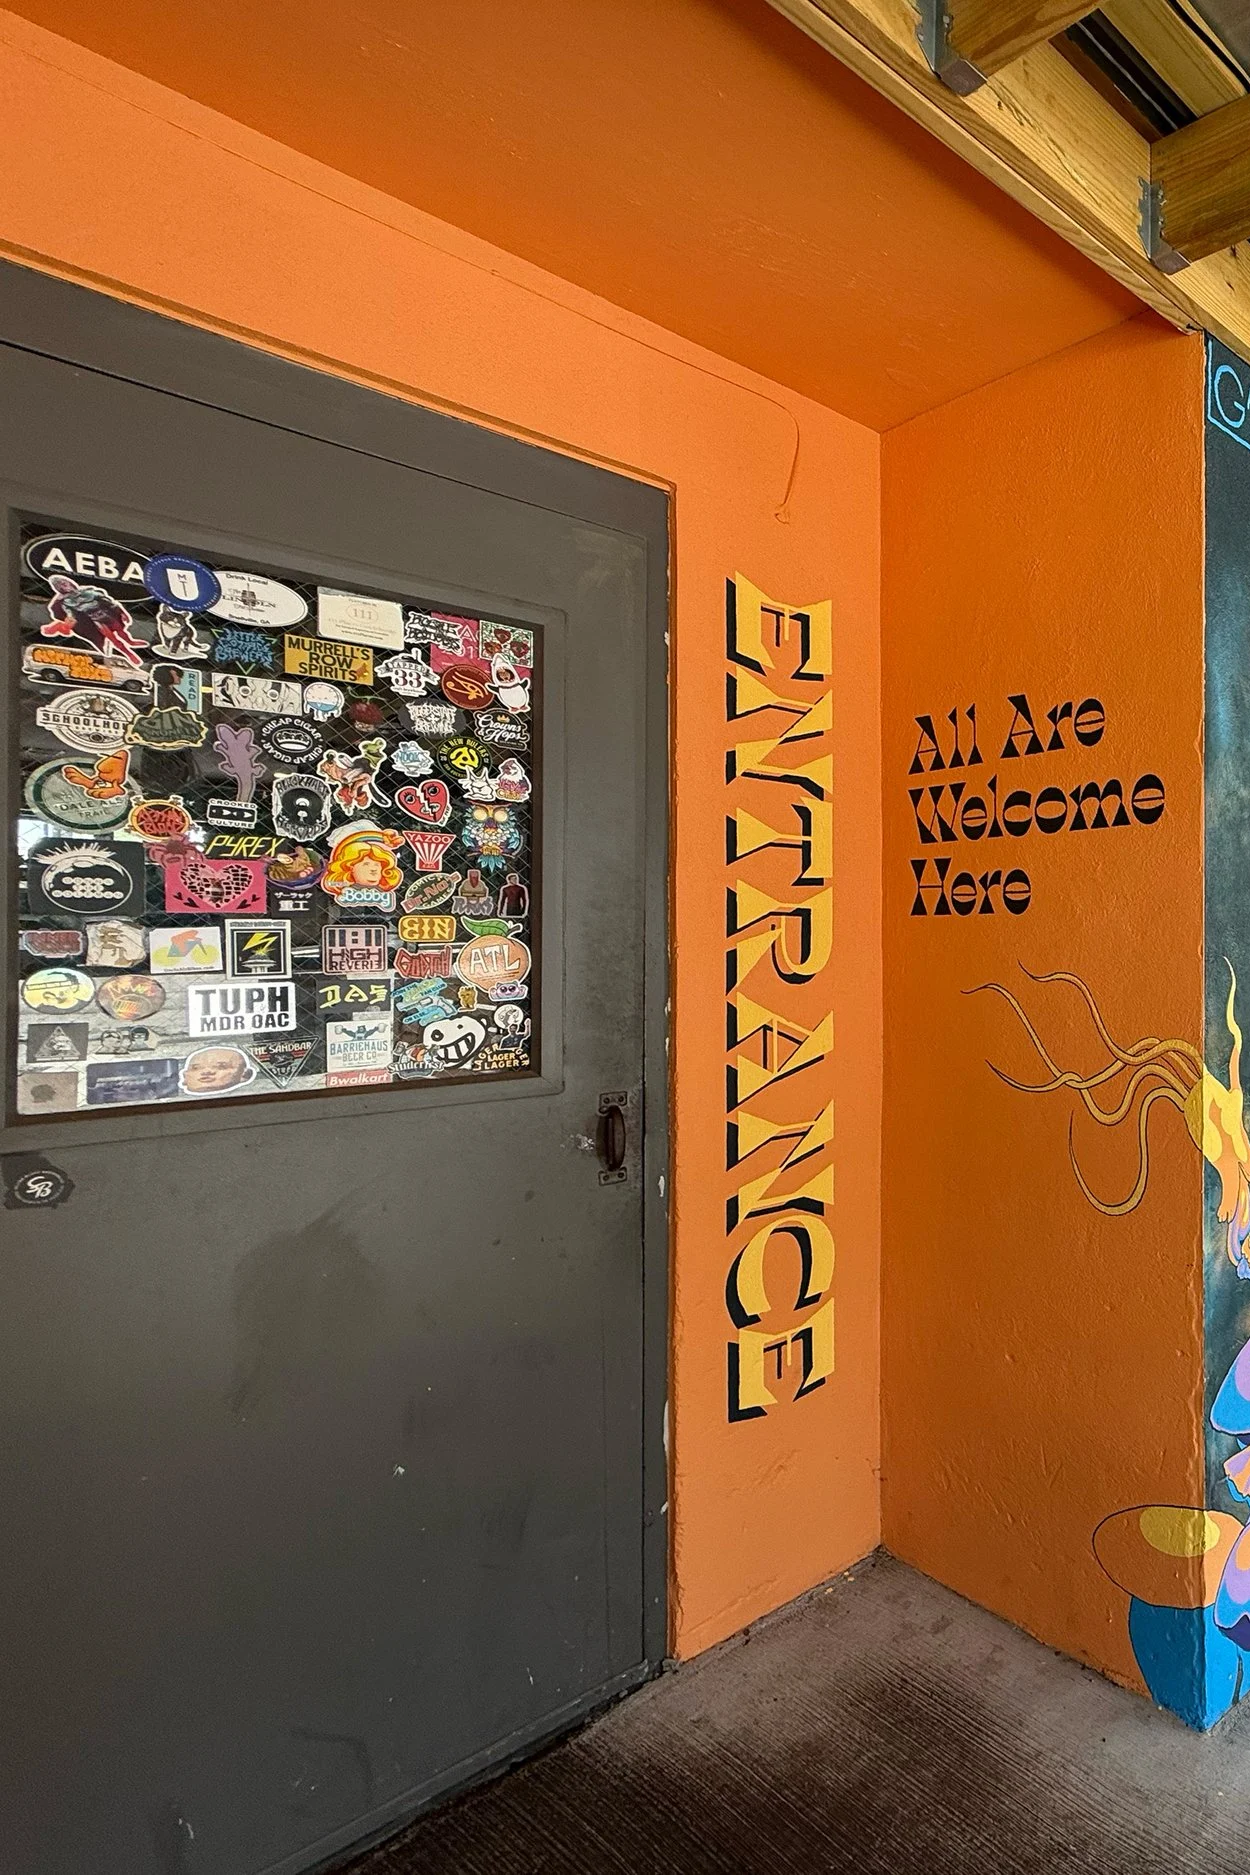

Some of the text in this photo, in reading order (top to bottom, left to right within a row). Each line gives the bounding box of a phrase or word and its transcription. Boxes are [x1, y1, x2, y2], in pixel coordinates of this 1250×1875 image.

[42, 547, 145, 582] AEBA
[225, 573, 268, 586] Drink Local
[287, 637, 371, 660] MURRELL'S
[309, 651, 354, 672] ROW
[299, 662, 358, 681] SPIRITS
[394, 669, 422, 688] 33
[188, 673, 197, 700] READ
[478, 714, 522, 732] Crowns
[449, 738, 464, 747] NEW
[483, 728, 528, 743] Hops
[907, 693, 1107, 775] All Are
[210, 799, 256, 809] CROOKED
[907, 773, 1166, 846] Welcome
[209, 819, 254, 828] CULTURE
[408, 833, 451, 843] YAZOO
[909, 857, 1033, 917] Here
[340, 889, 391, 905] Bobby
[470, 943, 520, 975] ATL
[195, 986, 289, 1016] TUPH
[725, 570, 835, 1424] ENTRANCE
[200, 1012, 290, 1032] MDR OAC
[268, 1041, 312, 1054] SANDBAR
[329, 1039, 388, 1056] BARRIEHAUS
[342, 1050, 363, 1062] BEER
[484, 1059, 520, 1070] LAGER
[487, 1053, 515, 1062] LAGER
[330, 1072, 388, 1086] Bwalkart
